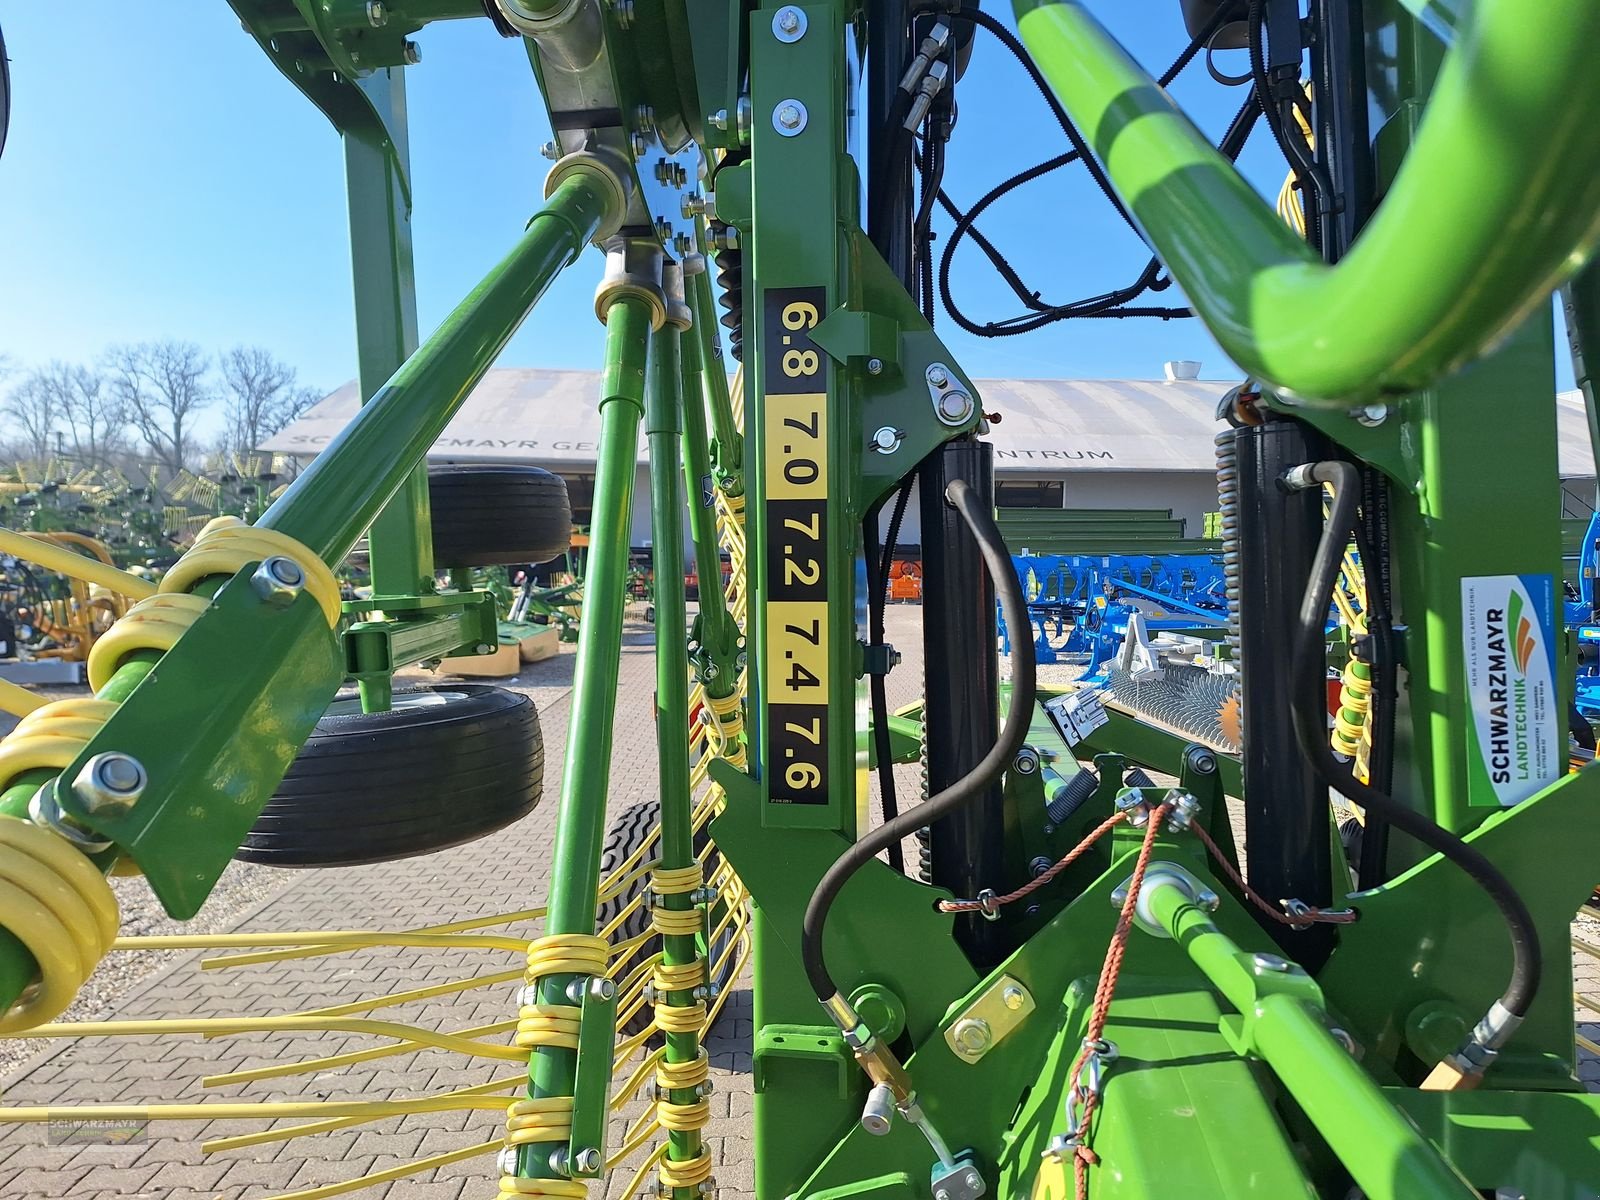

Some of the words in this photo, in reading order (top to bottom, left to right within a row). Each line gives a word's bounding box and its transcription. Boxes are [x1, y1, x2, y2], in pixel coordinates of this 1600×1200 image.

[782, 301, 819, 378] 6.8
[783, 411, 819, 486] 7.0
[784, 513, 820, 587] 7.2
[1381, 556, 1389, 579] PLUS
[784, 619, 820, 692] 7.4
[1486, 608, 1511, 784] SCHWARZMAYR
[1513, 678, 1530, 780] LANDTECHNIK
[784, 717, 821, 790] 7.6
